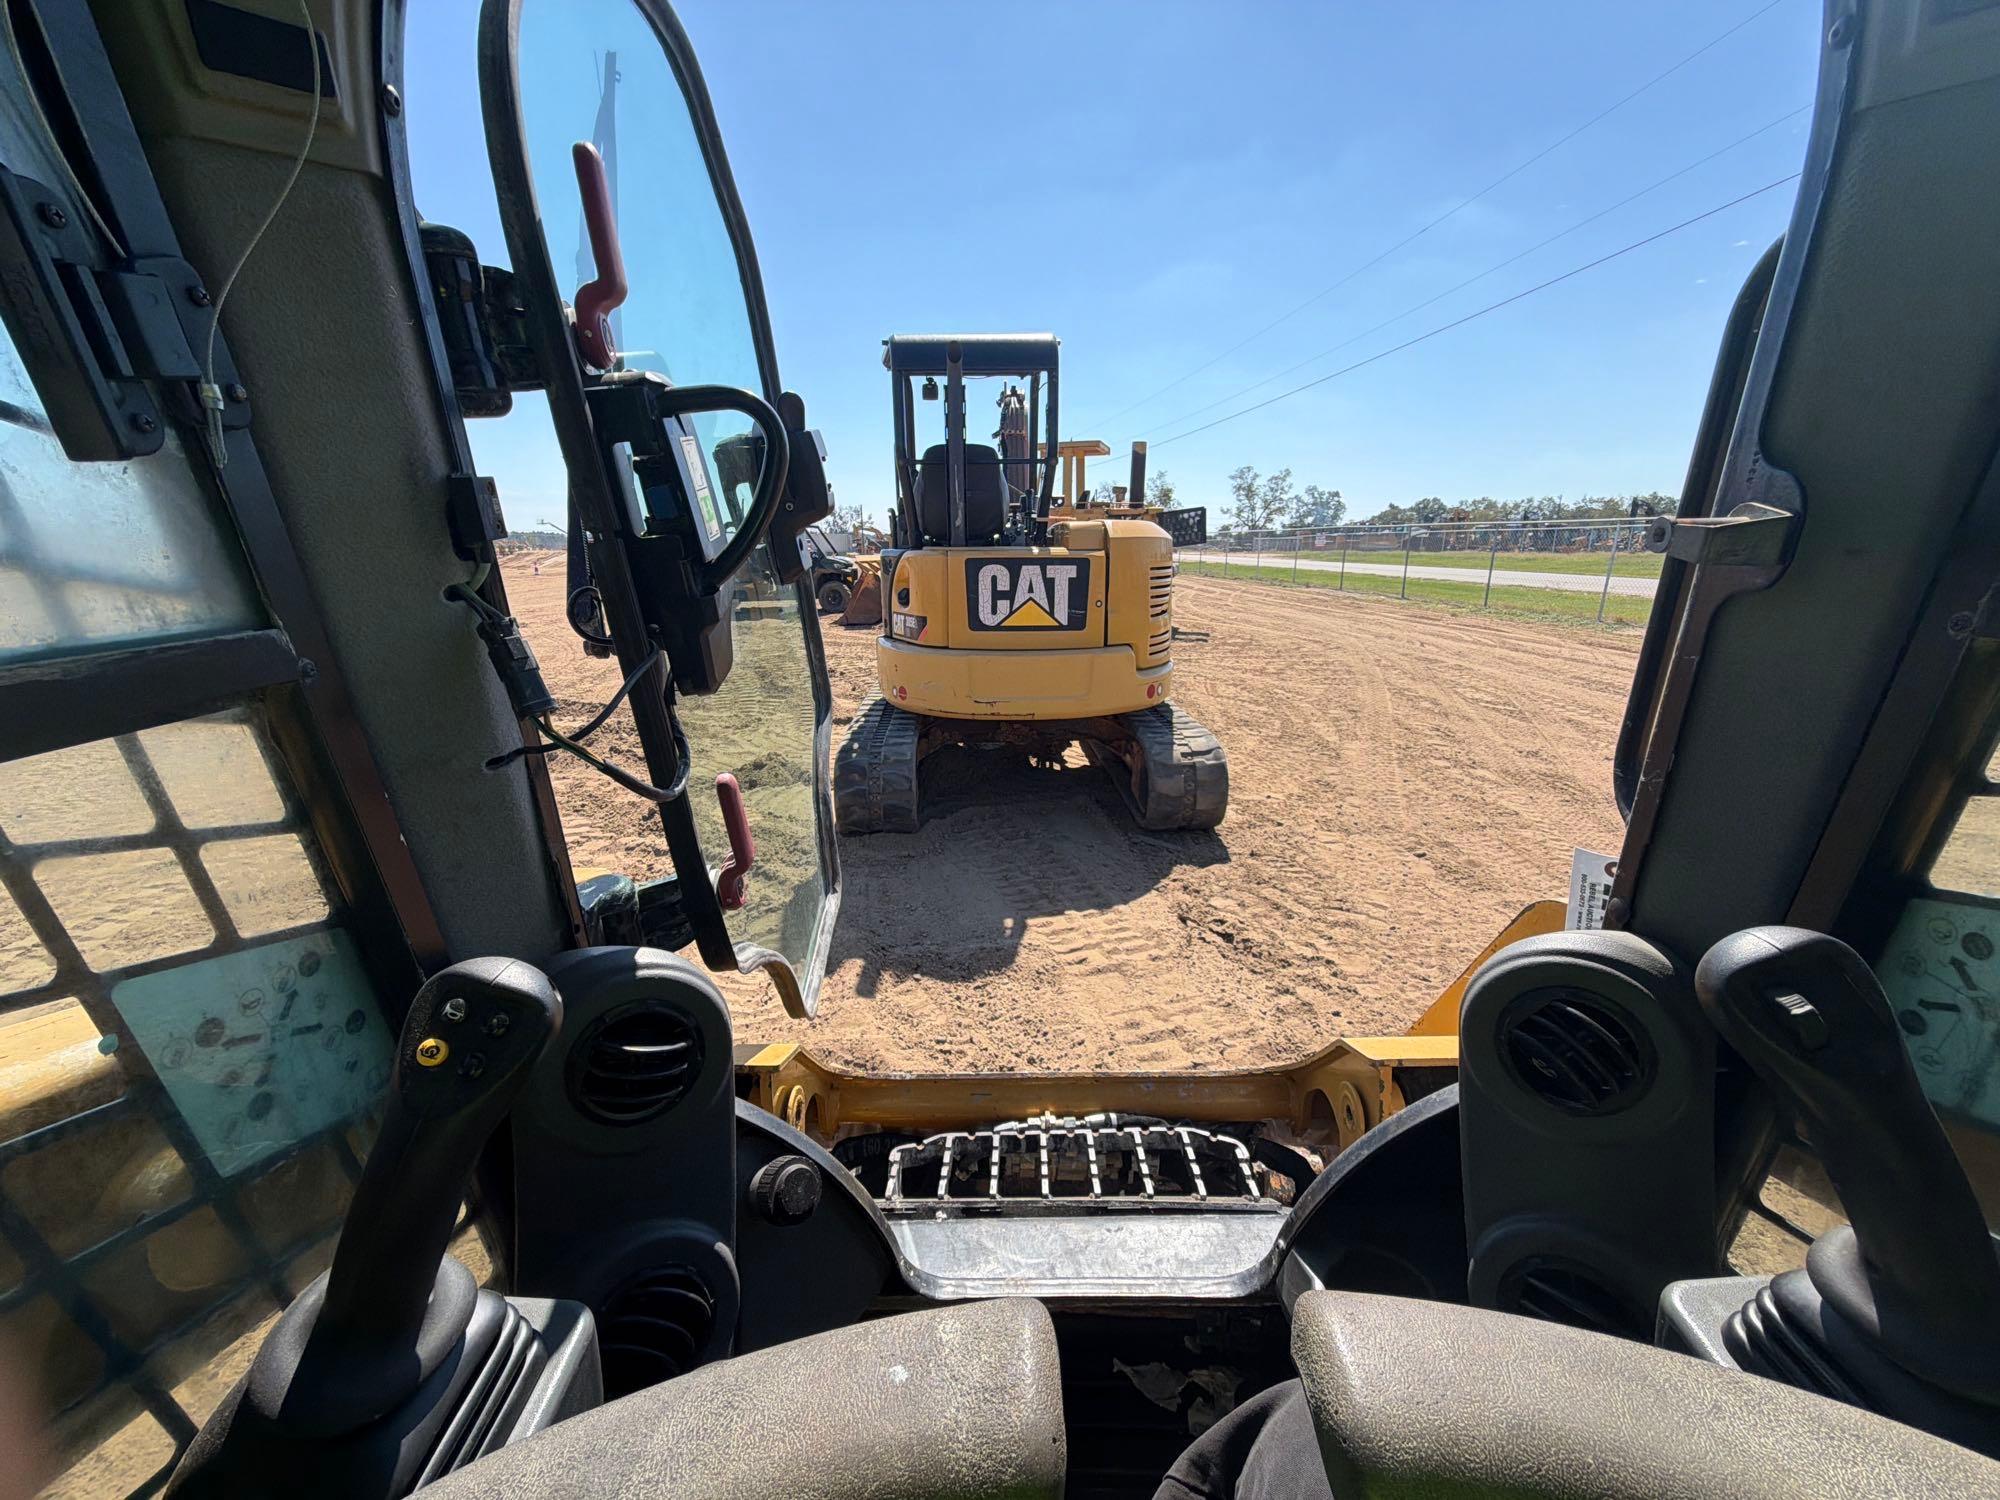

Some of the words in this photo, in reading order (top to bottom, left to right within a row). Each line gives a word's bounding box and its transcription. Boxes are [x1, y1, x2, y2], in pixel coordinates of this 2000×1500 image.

[978, 564, 1077, 626] CAT
[894, 613, 905, 635] CAT
[1587, 882, 1597, 903] REBEL
